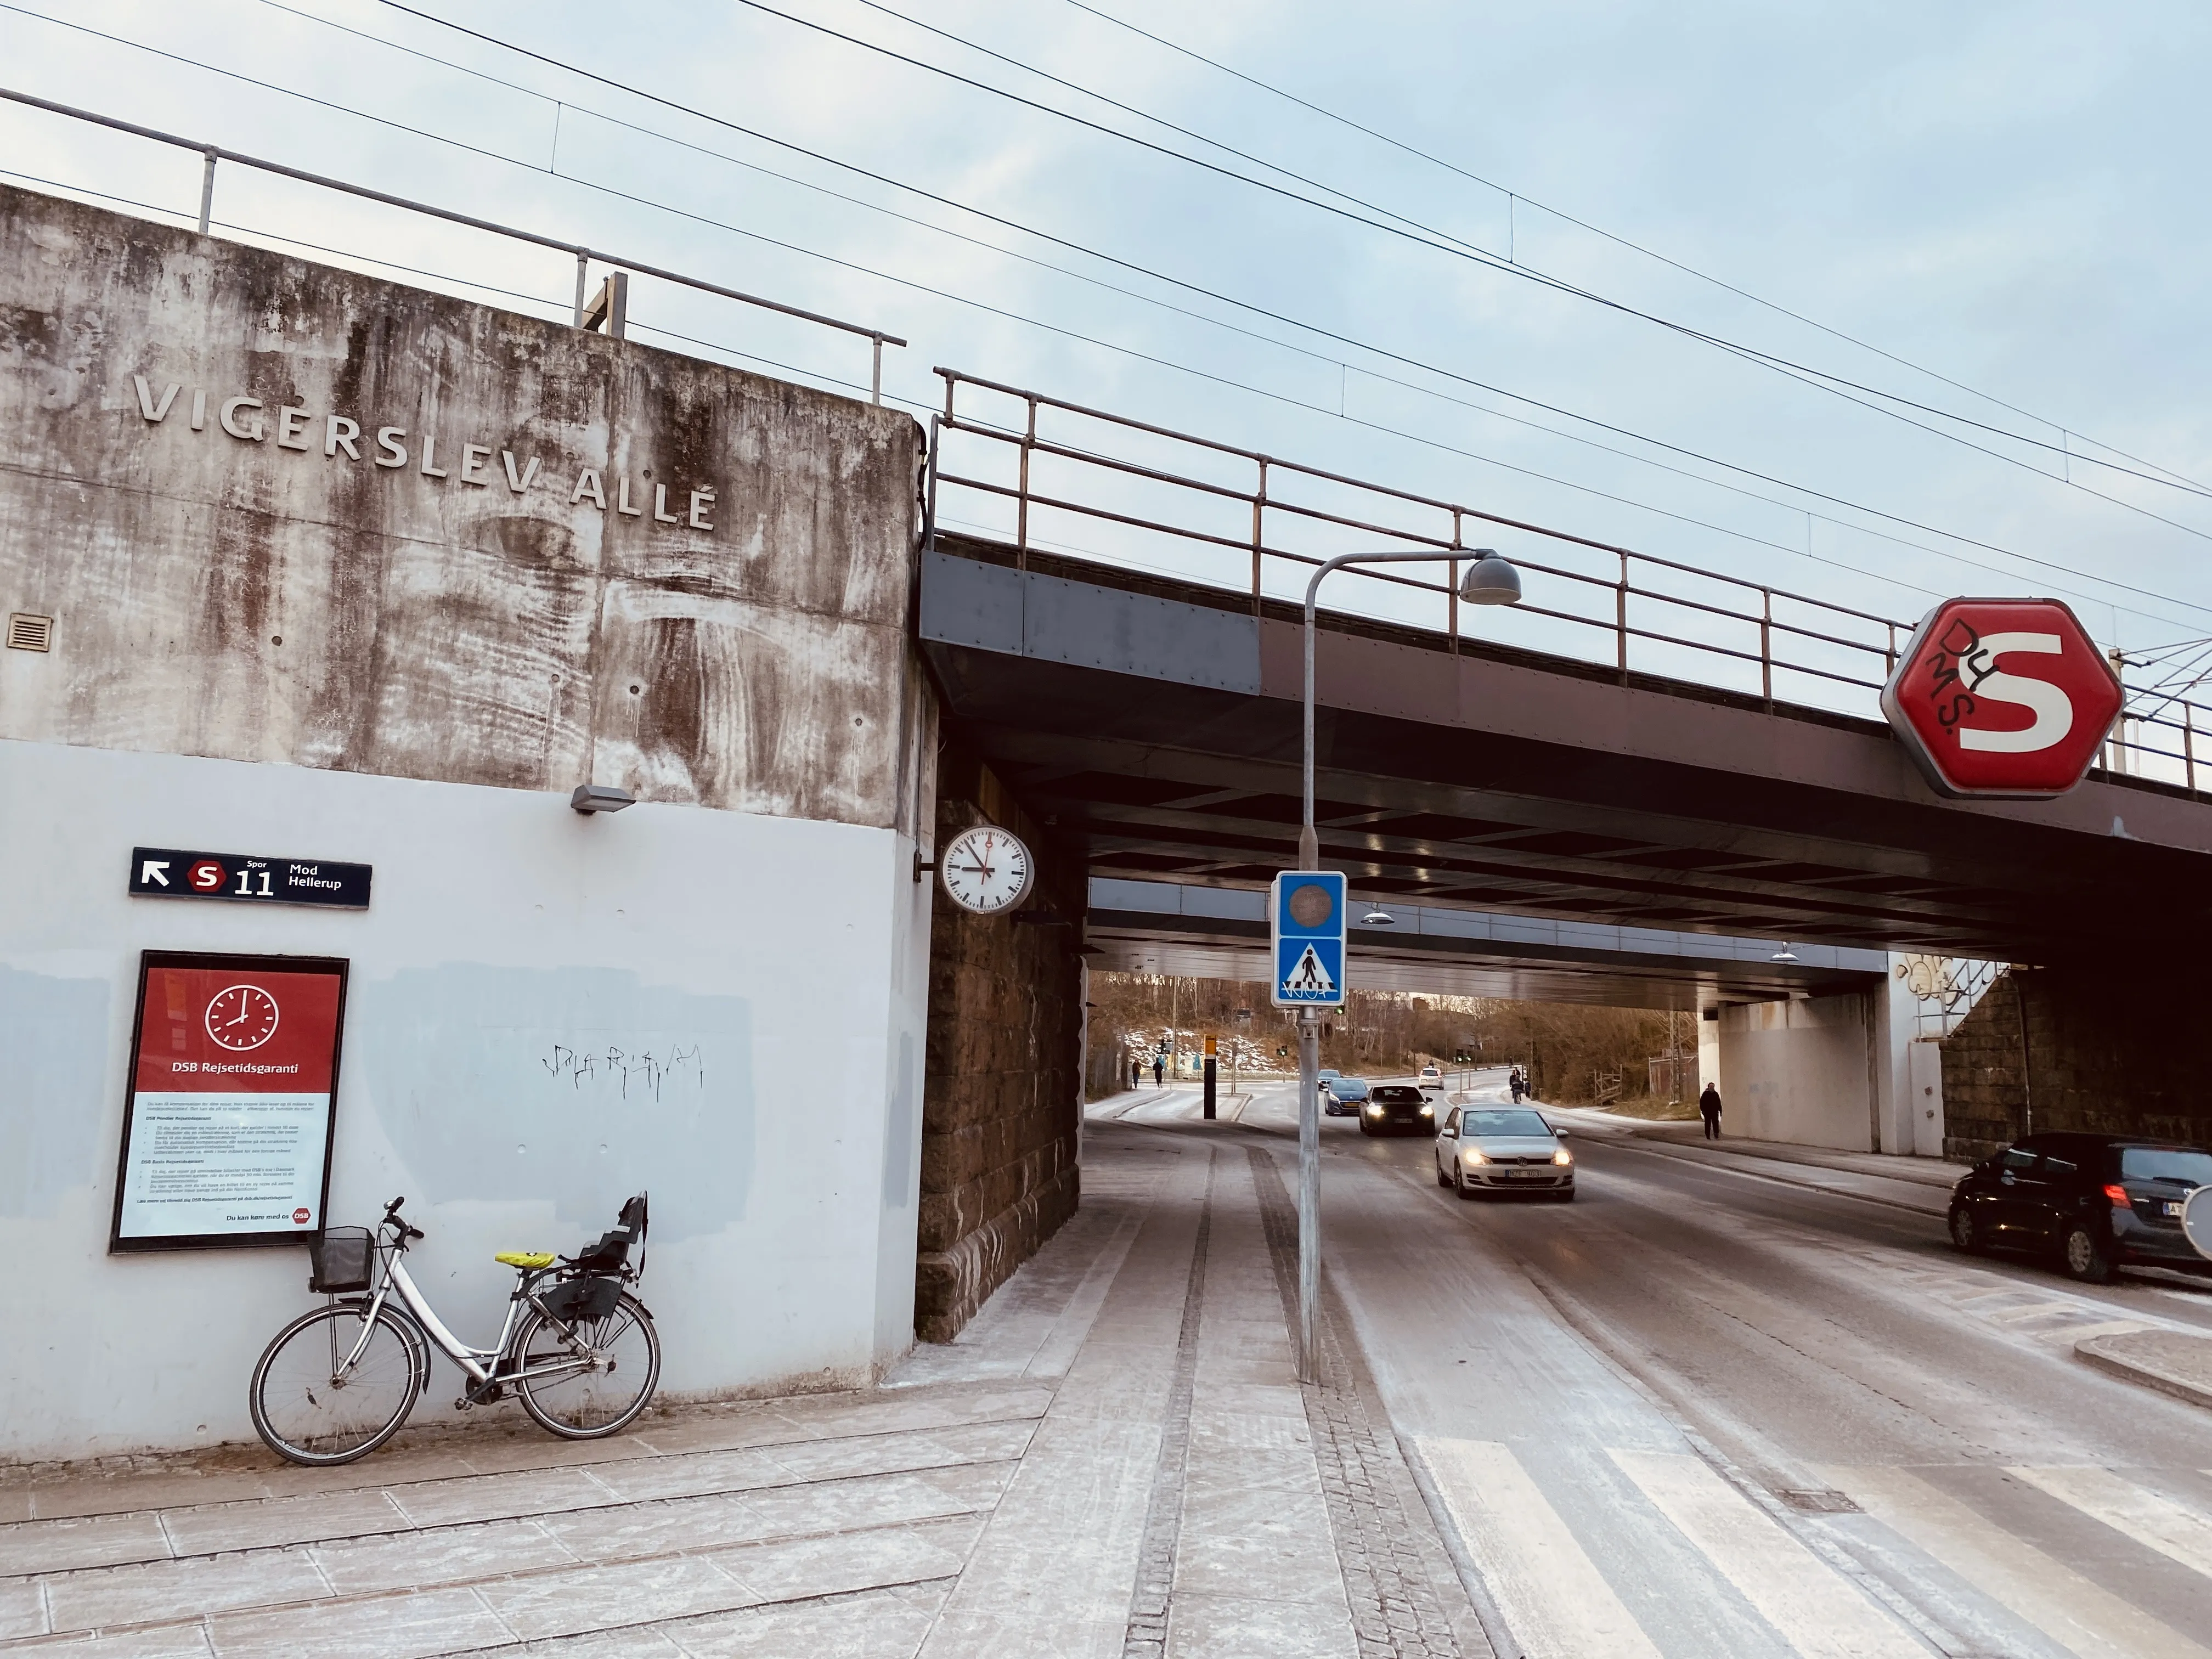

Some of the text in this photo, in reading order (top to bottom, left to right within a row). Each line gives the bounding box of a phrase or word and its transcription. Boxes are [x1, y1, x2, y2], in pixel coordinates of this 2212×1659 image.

[133, 374, 715, 531] VIGERSLEV ALLÉ
[1959, 631, 2073, 753] S
[247, 860, 267, 868] Spor
[290, 865, 318, 875] Mod
[195, 866, 274, 896] S 11
[289, 876, 342, 890] Hellerup
[172, 1062, 298, 1075] DSB Rejsetidsgaranti
